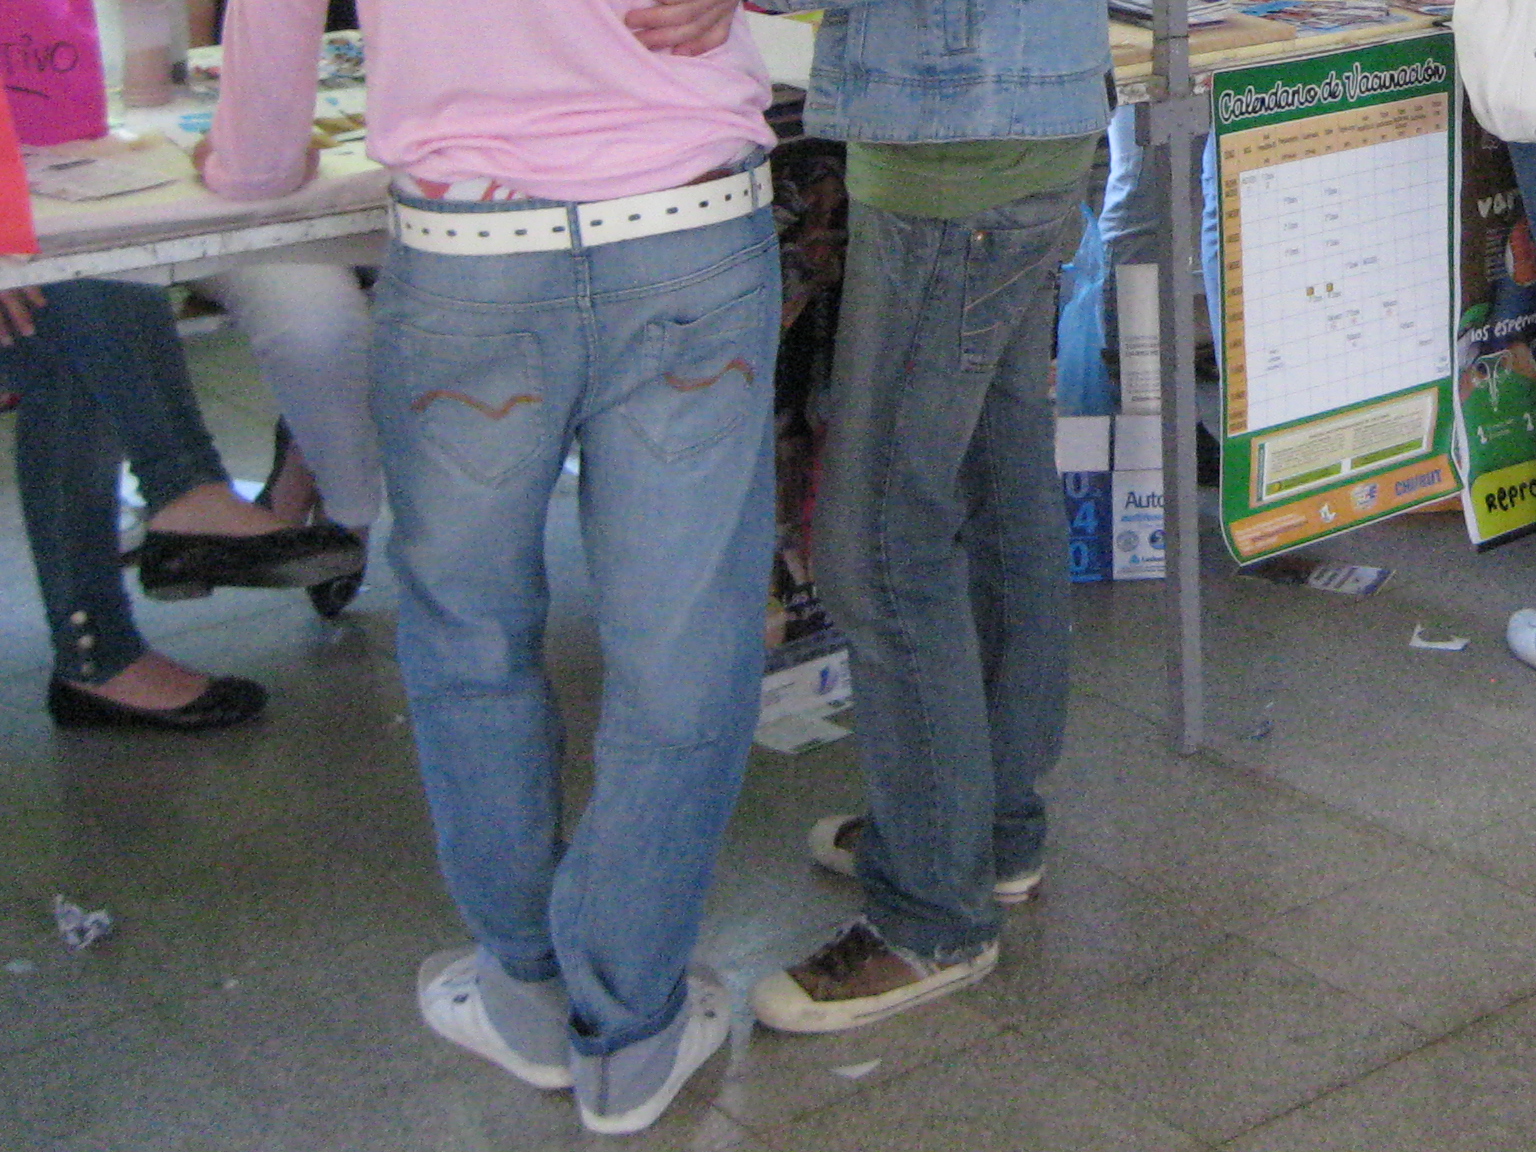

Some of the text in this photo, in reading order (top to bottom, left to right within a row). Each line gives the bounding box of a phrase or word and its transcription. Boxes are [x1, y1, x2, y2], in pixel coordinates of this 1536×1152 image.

[1218, 58, 1447, 124] Calendario de Vacunación
